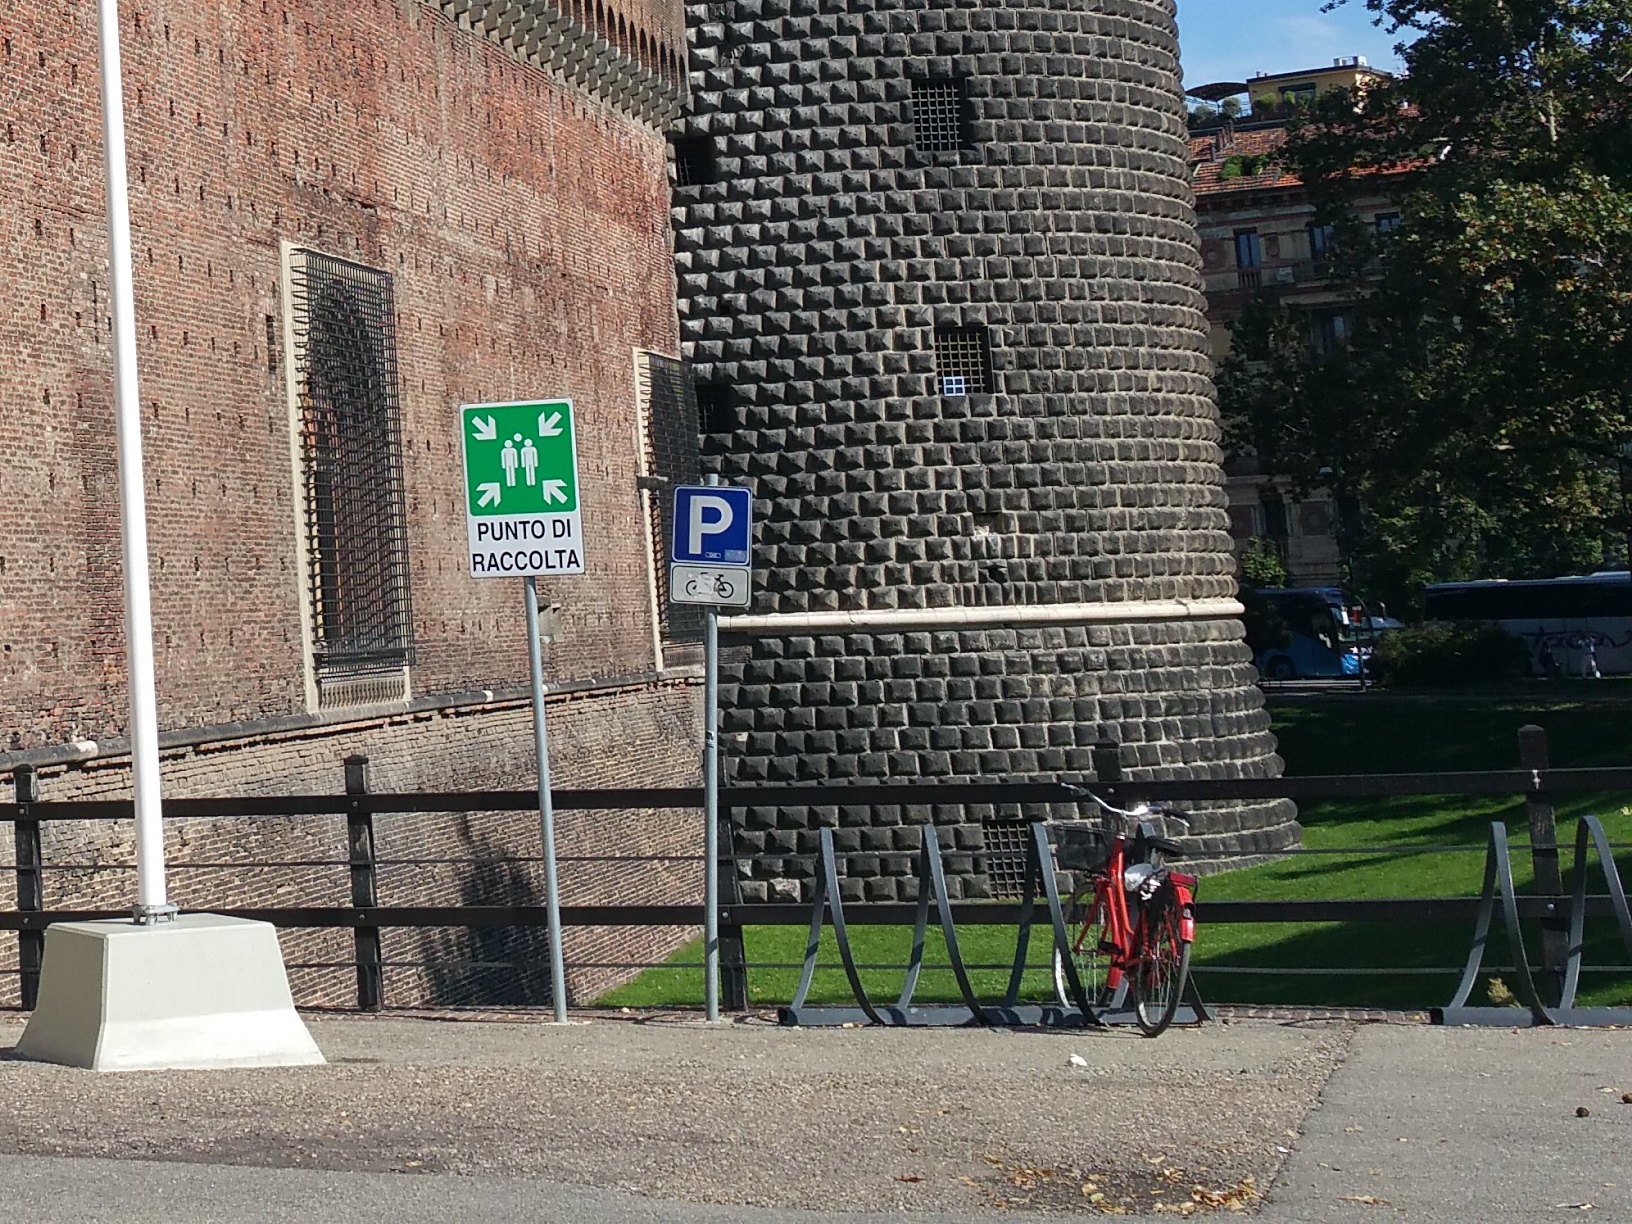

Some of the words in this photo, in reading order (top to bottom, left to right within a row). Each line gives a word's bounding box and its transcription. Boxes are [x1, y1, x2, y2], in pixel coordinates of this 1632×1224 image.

[477, 520, 546, 542] PUNTO
[552, 519, 572, 539] DI
[688, 494, 734, 555] P
[472, 549, 581, 572] RACCOLTA
